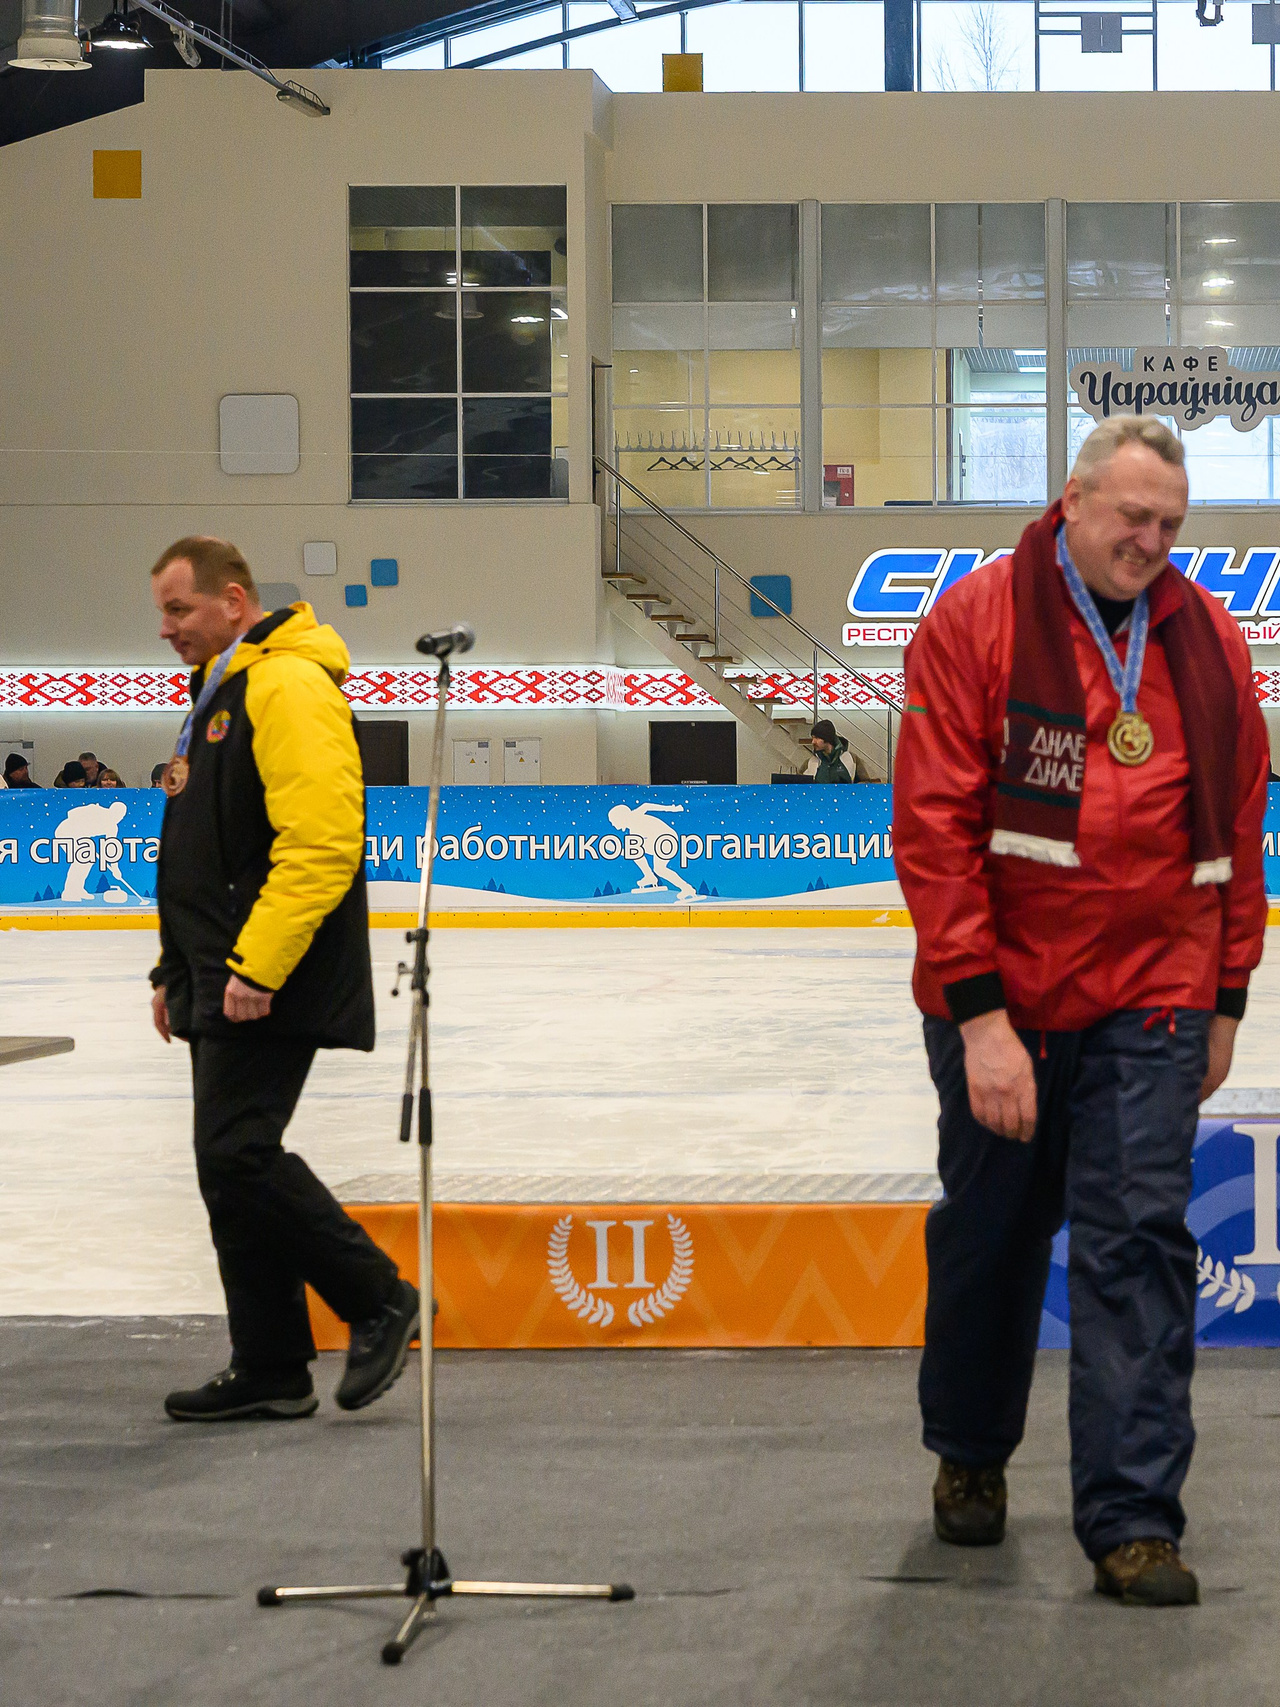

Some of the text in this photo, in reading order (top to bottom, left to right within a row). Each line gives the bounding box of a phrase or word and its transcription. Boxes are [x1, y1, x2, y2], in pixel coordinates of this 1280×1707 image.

[1143, 356, 1218, 372] КАФЕ
[30, 837, 160, 872] спарта
[416, 824, 645, 869] работников
[586, 1220, 655, 1290] II
